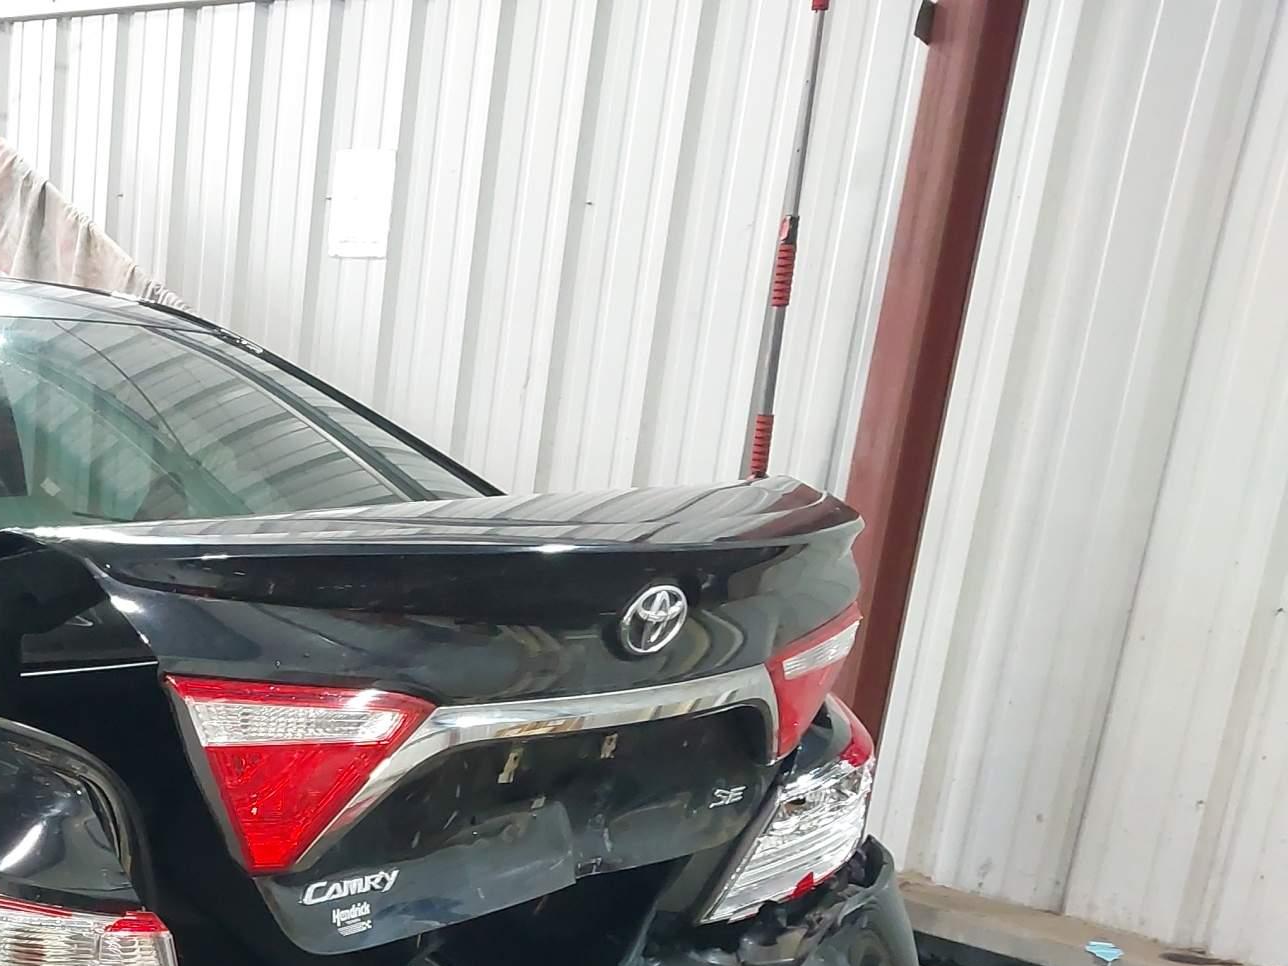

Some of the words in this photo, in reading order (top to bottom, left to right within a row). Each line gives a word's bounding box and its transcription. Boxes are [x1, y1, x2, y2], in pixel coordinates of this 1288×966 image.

[708, 786, 747, 808] SE
[298, 869, 400, 906] CAMRY
[332, 901, 371, 927] Hendrick
